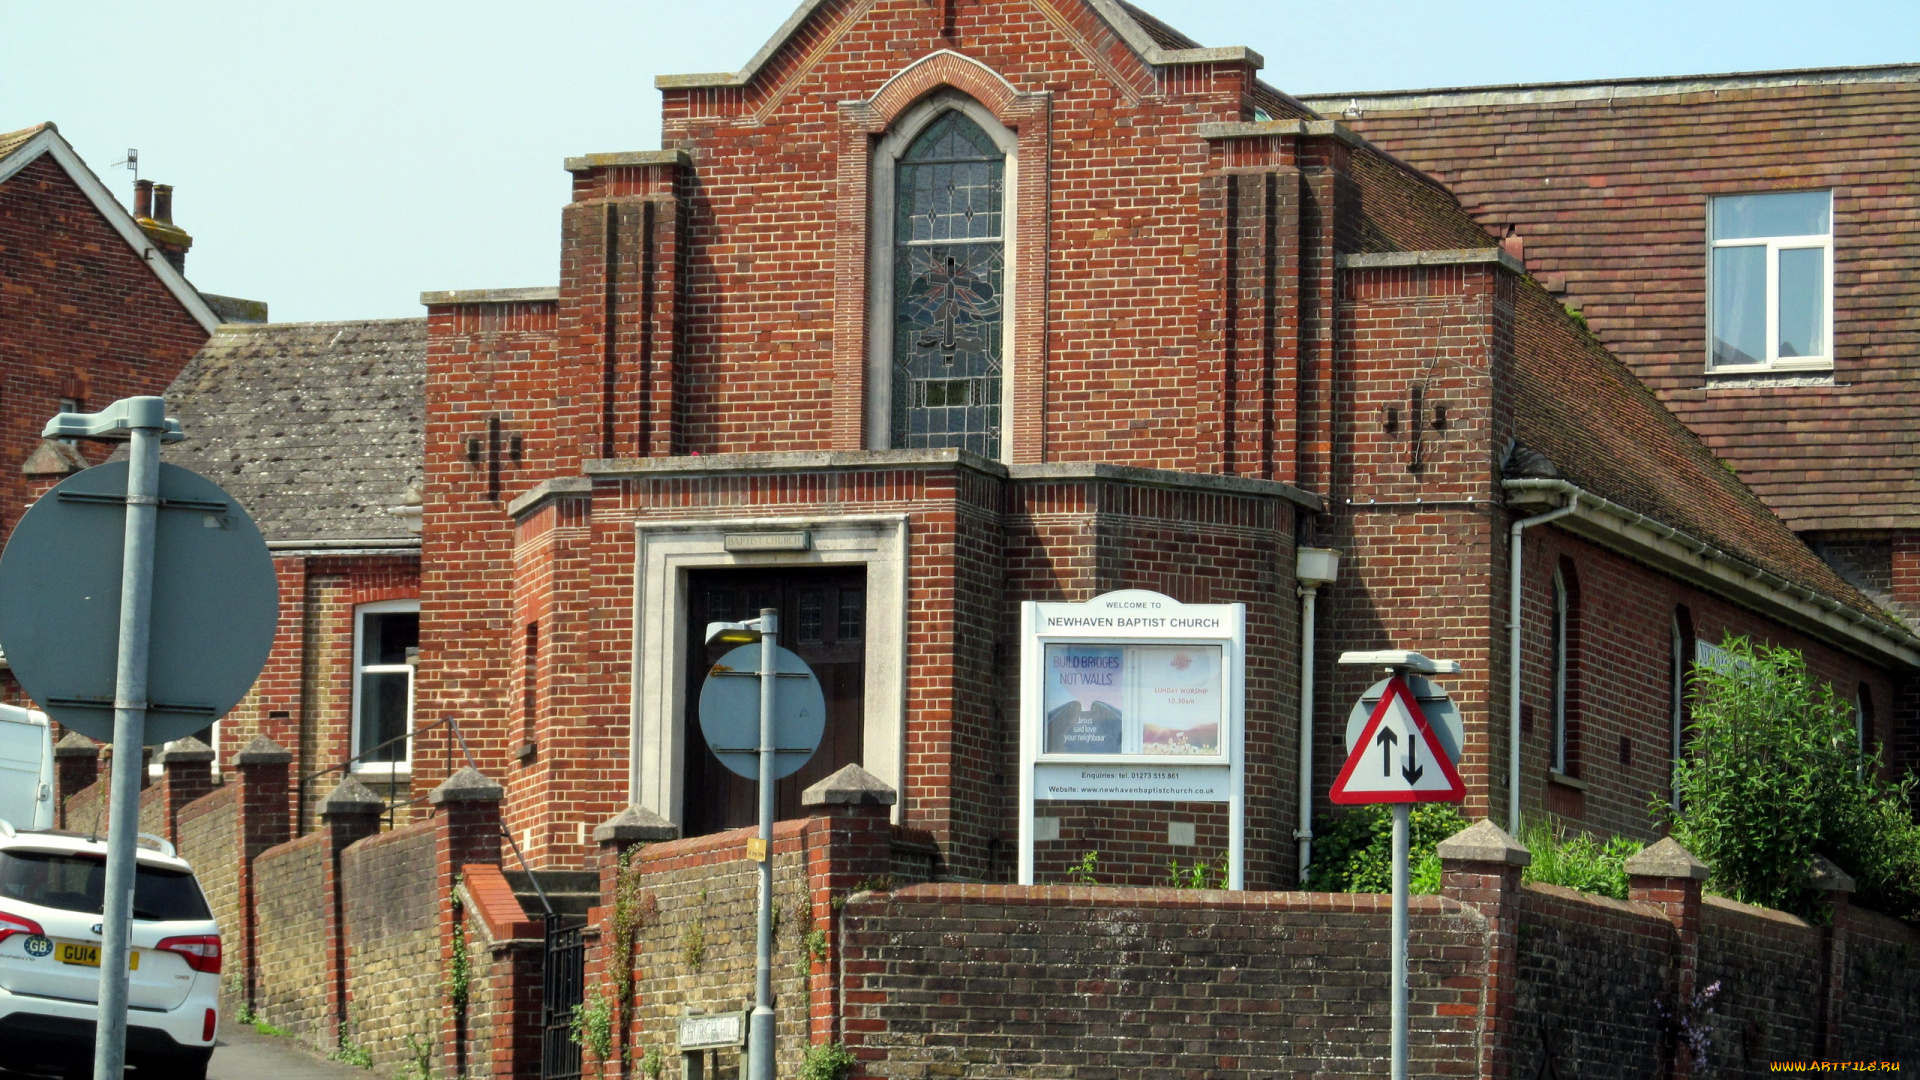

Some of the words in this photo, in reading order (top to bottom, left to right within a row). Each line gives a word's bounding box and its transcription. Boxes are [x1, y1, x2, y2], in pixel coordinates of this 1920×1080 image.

[728, 536, 762, 545] BAPTIST
[766, 536, 800, 545] CHURCH
[1048, 617, 1113, 627] NEWHAVEN
[1118, 618, 1166, 627] BAPTIST
[1170, 618, 1219, 628] CHURCH
[1054, 656, 1079, 668] BUILD
[1081, 656, 1119, 668] BRIDGES
[1060, 673, 1079, 685] NOT
[1080, 673, 1112, 685] WALLS
[1077, 734, 1105, 743] neighbour
[1082, 772, 1117, 780] Enquiries:
[1081, 786, 1214, 794] www.newhavenbaptistchurch.co.uk
[30, 940, 47, 952] GB
[682, 1022, 717, 1041] CHURCH
[720, 1020, 738, 1038] HILL
